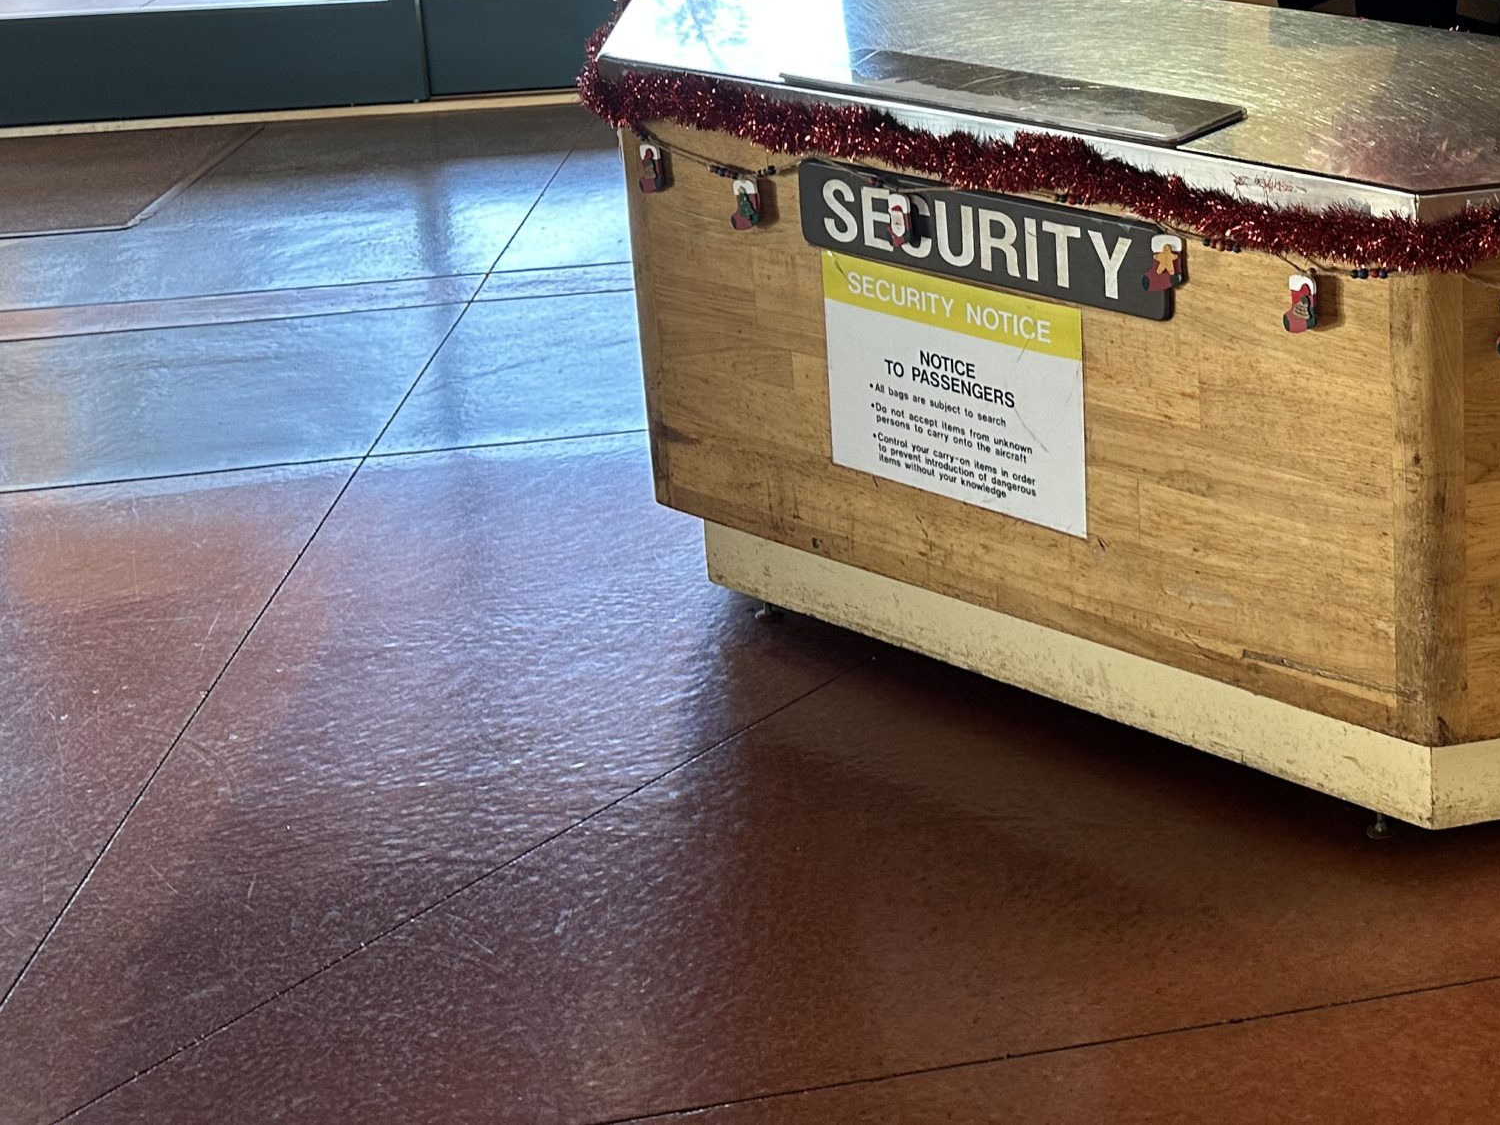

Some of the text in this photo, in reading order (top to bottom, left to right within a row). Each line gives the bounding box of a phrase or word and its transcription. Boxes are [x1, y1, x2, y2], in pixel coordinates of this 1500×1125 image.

[822, 179, 1132, 300] SECURITY
[847, 271, 1052, 344] SECURITY NOTICE
[884, 359, 1016, 409] TO PASSENGERS
[919, 350, 976, 379] NOTICE
[875, 382, 1006, 427] All bags are subject to search
[875, 402, 1033, 455] Do not accept items from unknown
[876, 414, 1027, 464] persons to carry onto the aircraft
[877, 431, 1036, 486] Control your carry-on items in order
[878, 442, 1037, 497] to prevent introduction of dangerous
[878, 452, 1007, 498] items without your knowledge
